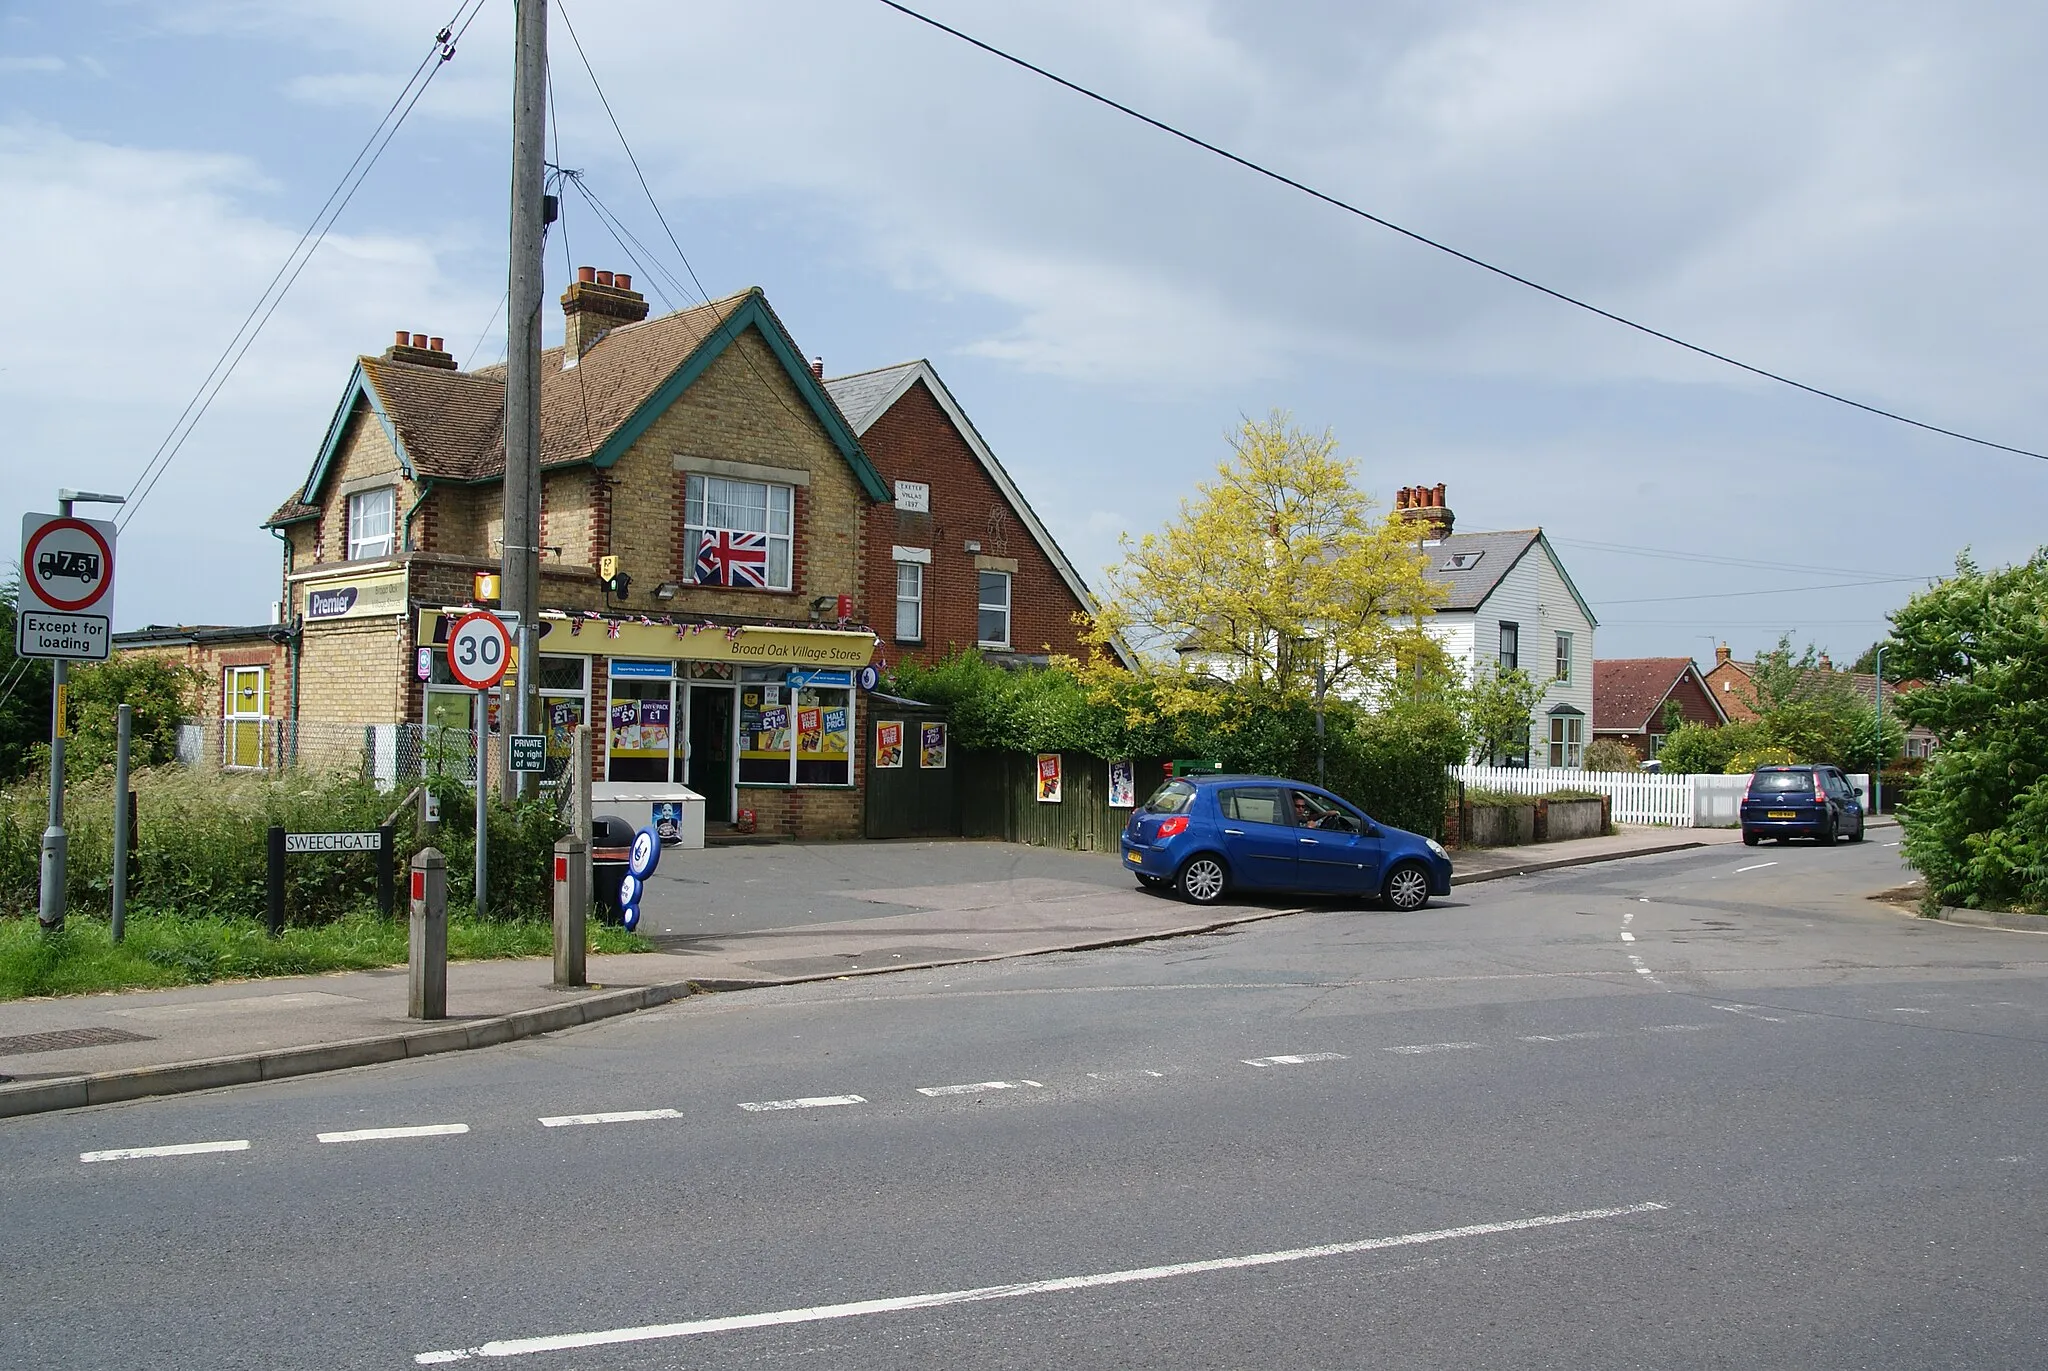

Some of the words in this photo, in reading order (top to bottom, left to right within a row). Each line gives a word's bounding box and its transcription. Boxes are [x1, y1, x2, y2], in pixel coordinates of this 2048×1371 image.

[60, 553, 97, 571] 7.5T
[313, 593, 349, 615] Premier
[28, 618, 77, 635] Except
[83, 622, 103, 635] for
[39, 635, 90, 652] loading
[459, 635, 501, 666] 30
[731, 642, 766, 655] Broad
[767, 643, 788, 657] Oak
[791, 645, 828, 661] Village
[829, 647, 861, 660] Stores
[555, 703, 570, 711] ONLY
[765, 709, 781, 717] ONLY
[553, 710, 568, 724] £1
[621, 709, 635, 723] £9
[649, 710, 660, 720] £1
[826, 710, 844, 721] HALF
[802, 720, 818, 730] FREE
[826, 719, 845, 730] PRICE
[514, 738, 542, 748] PRIVATE
[513, 749, 524, 758] No
[526, 750, 542, 760] right
[515, 759, 524, 768] of
[526, 761, 540, 769] way
[287, 834, 380, 850] SWEECHGATE
